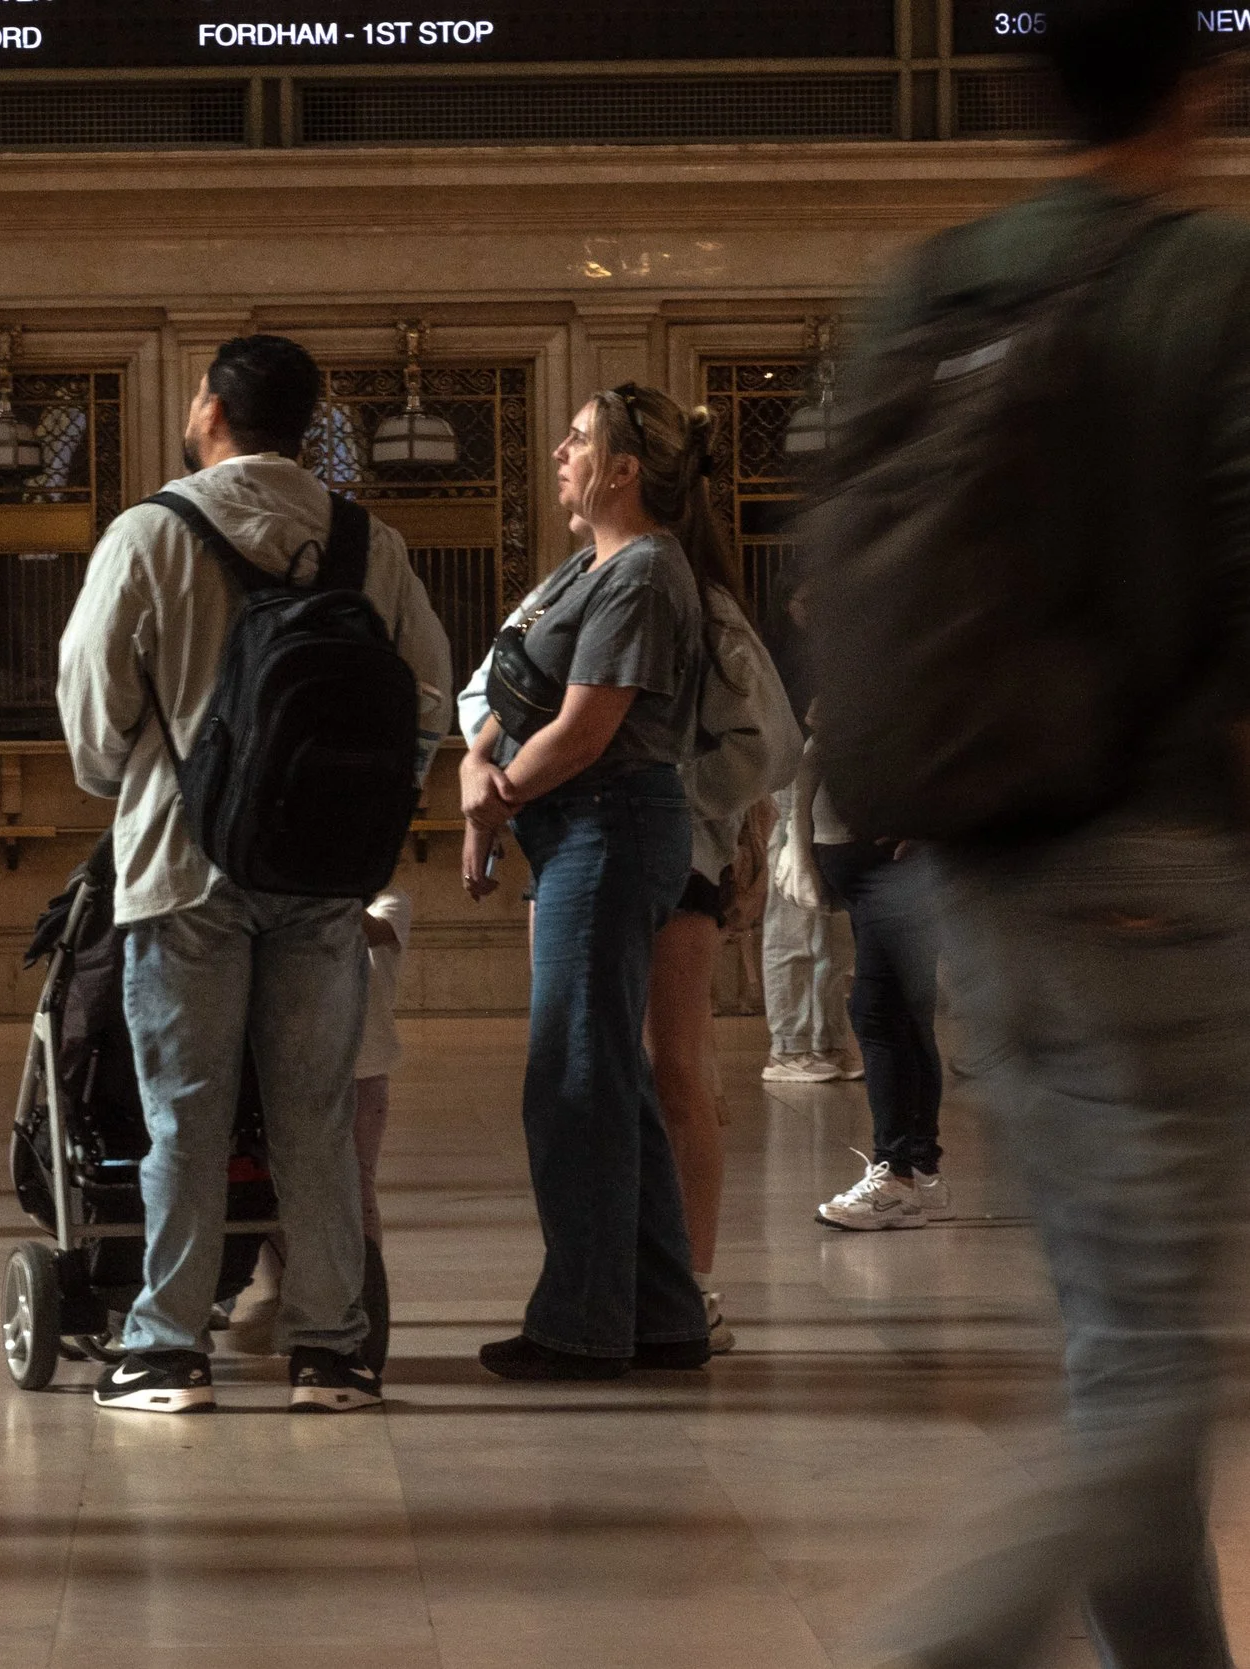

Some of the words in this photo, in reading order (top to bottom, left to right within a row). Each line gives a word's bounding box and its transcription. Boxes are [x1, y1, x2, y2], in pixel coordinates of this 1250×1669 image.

[198, 22, 338, 47] FORDHAM
[362, 21, 413, 46] 1ST
[418, 20, 494, 45] STOP
[994, 11, 1047, 35] 3:05
